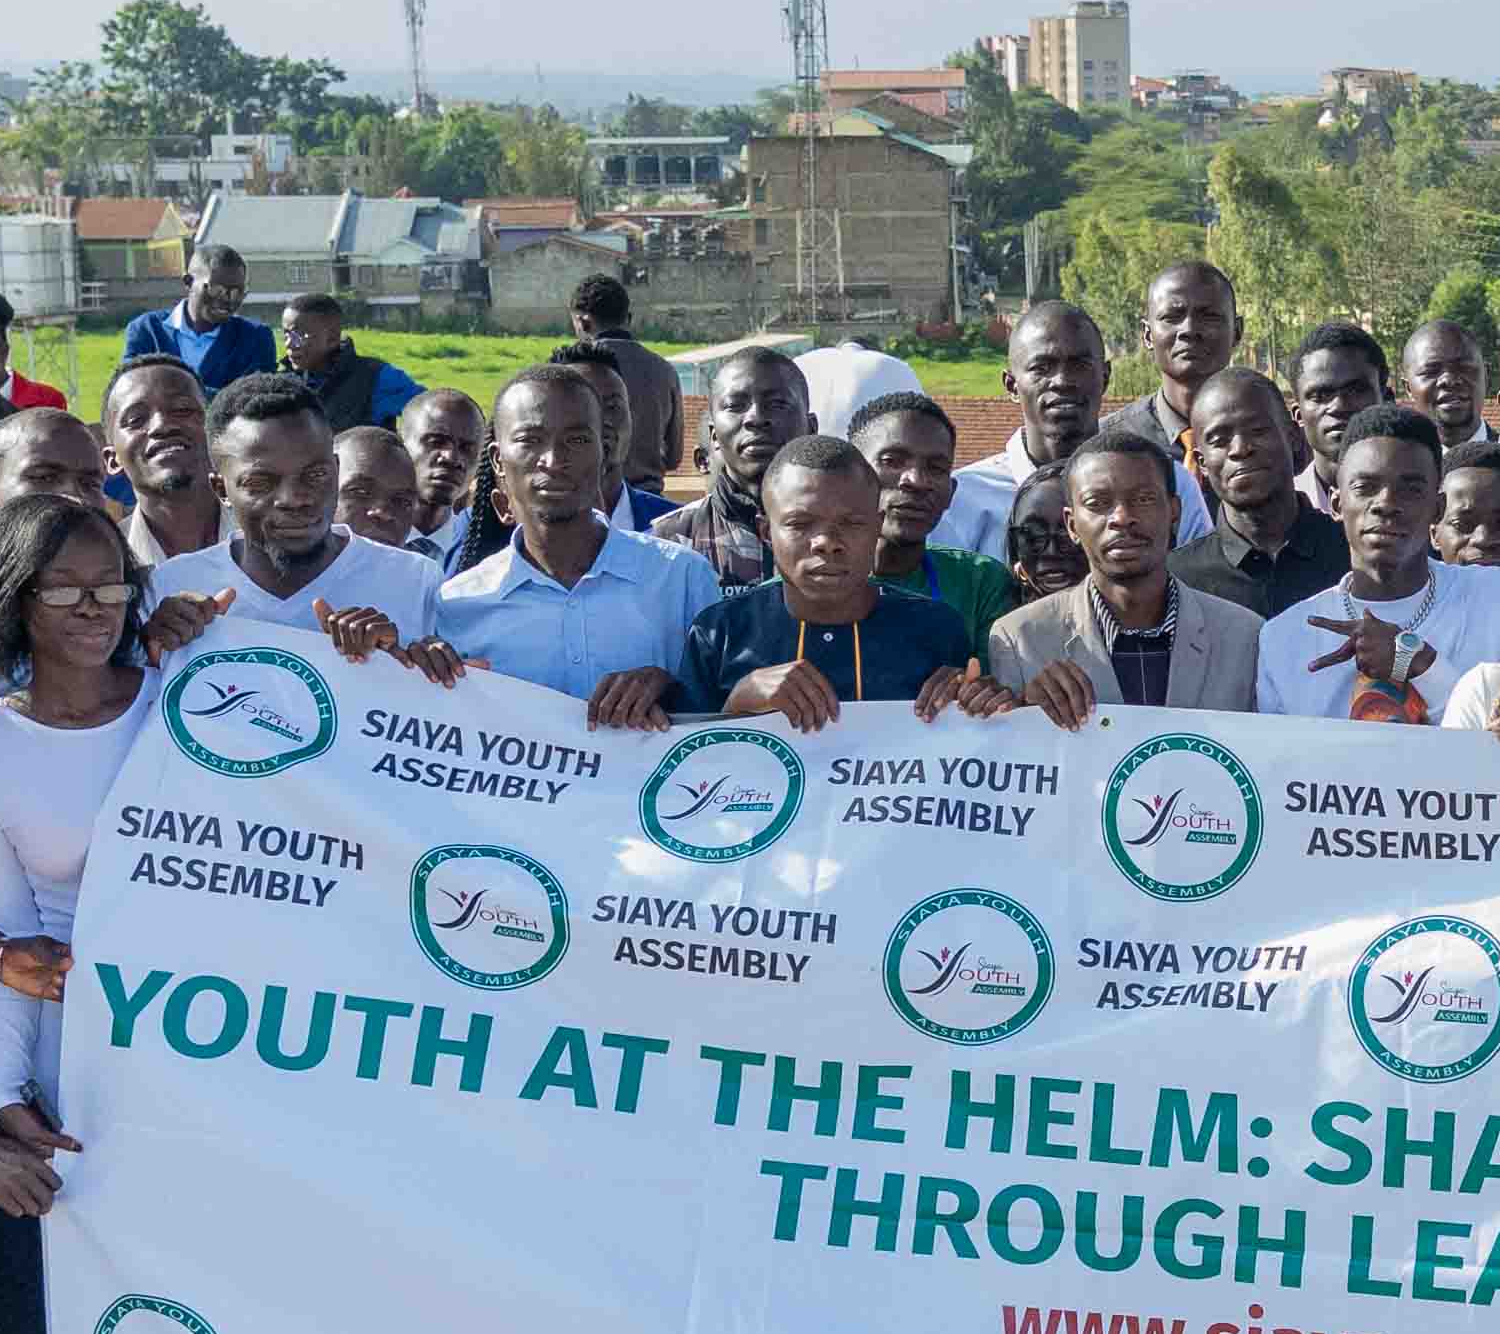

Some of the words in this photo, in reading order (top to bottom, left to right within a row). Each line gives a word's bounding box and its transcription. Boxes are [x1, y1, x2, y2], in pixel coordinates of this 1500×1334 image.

[272, 654, 330, 722] YOUTH
[186, 740, 282, 772] ASSEMBLY
[361, 709, 463, 757] SIAYA
[478, 731, 601, 778] YOUTH
[658, 733, 716, 779] SIAYA
[731, 731, 799, 779] YOUTH
[371, 752, 570, 804] ASSEMBLY
[827, 758, 926, 786] SIAYA
[939, 757, 1059, 796] YOUTH
[1112, 740, 1171, 792] SIAYA
[1183, 739, 1254, 800] YOUTH
[842, 795, 1035, 837] ASSEMBLY
[1284, 781, 1387, 818] SIAYA
[116, 803, 223, 849] SIAYA
[237, 820, 364, 871] YOUTH
[661, 835, 758, 858] ASSEMBLY
[1306, 827, 1500, 862] ASSEMBLY
[130, 852, 338, 908] ASSEMBLY
[417, 849, 481, 880] SIAYA
[498, 851, 561, 907] YOUTH
[1135, 870, 1227, 896] ASSEMBLY
[592, 895, 697, 931] SIAYA
[711, 904, 837, 944] YOUTH
[897, 895, 960, 941] SIAYA
[976, 895, 1046, 955] YOUTH
[438, 954, 535, 984] ASSEMBLY
[614, 936, 811, 983] ASSEMBLY
[1077, 938, 1180, 974] SIAYA
[1191, 945, 1307, 974] YOUTH
[1362, 922, 1427, 969] SIAYA
[1096, 981, 1278, 1012] ASSEMBLY
[914, 1015, 1012, 1040] ASSEMBLY
[94, 962, 493, 1094] YOUTH
[517, 1025, 671, 1115] AT
[699, 1044, 908, 1145] THE
[944, 1069, 1272, 1173] HELM:
[1378, 1049, 1476, 1077] ASSEMBLY
[759, 1159, 1306, 1288] THROUGH
